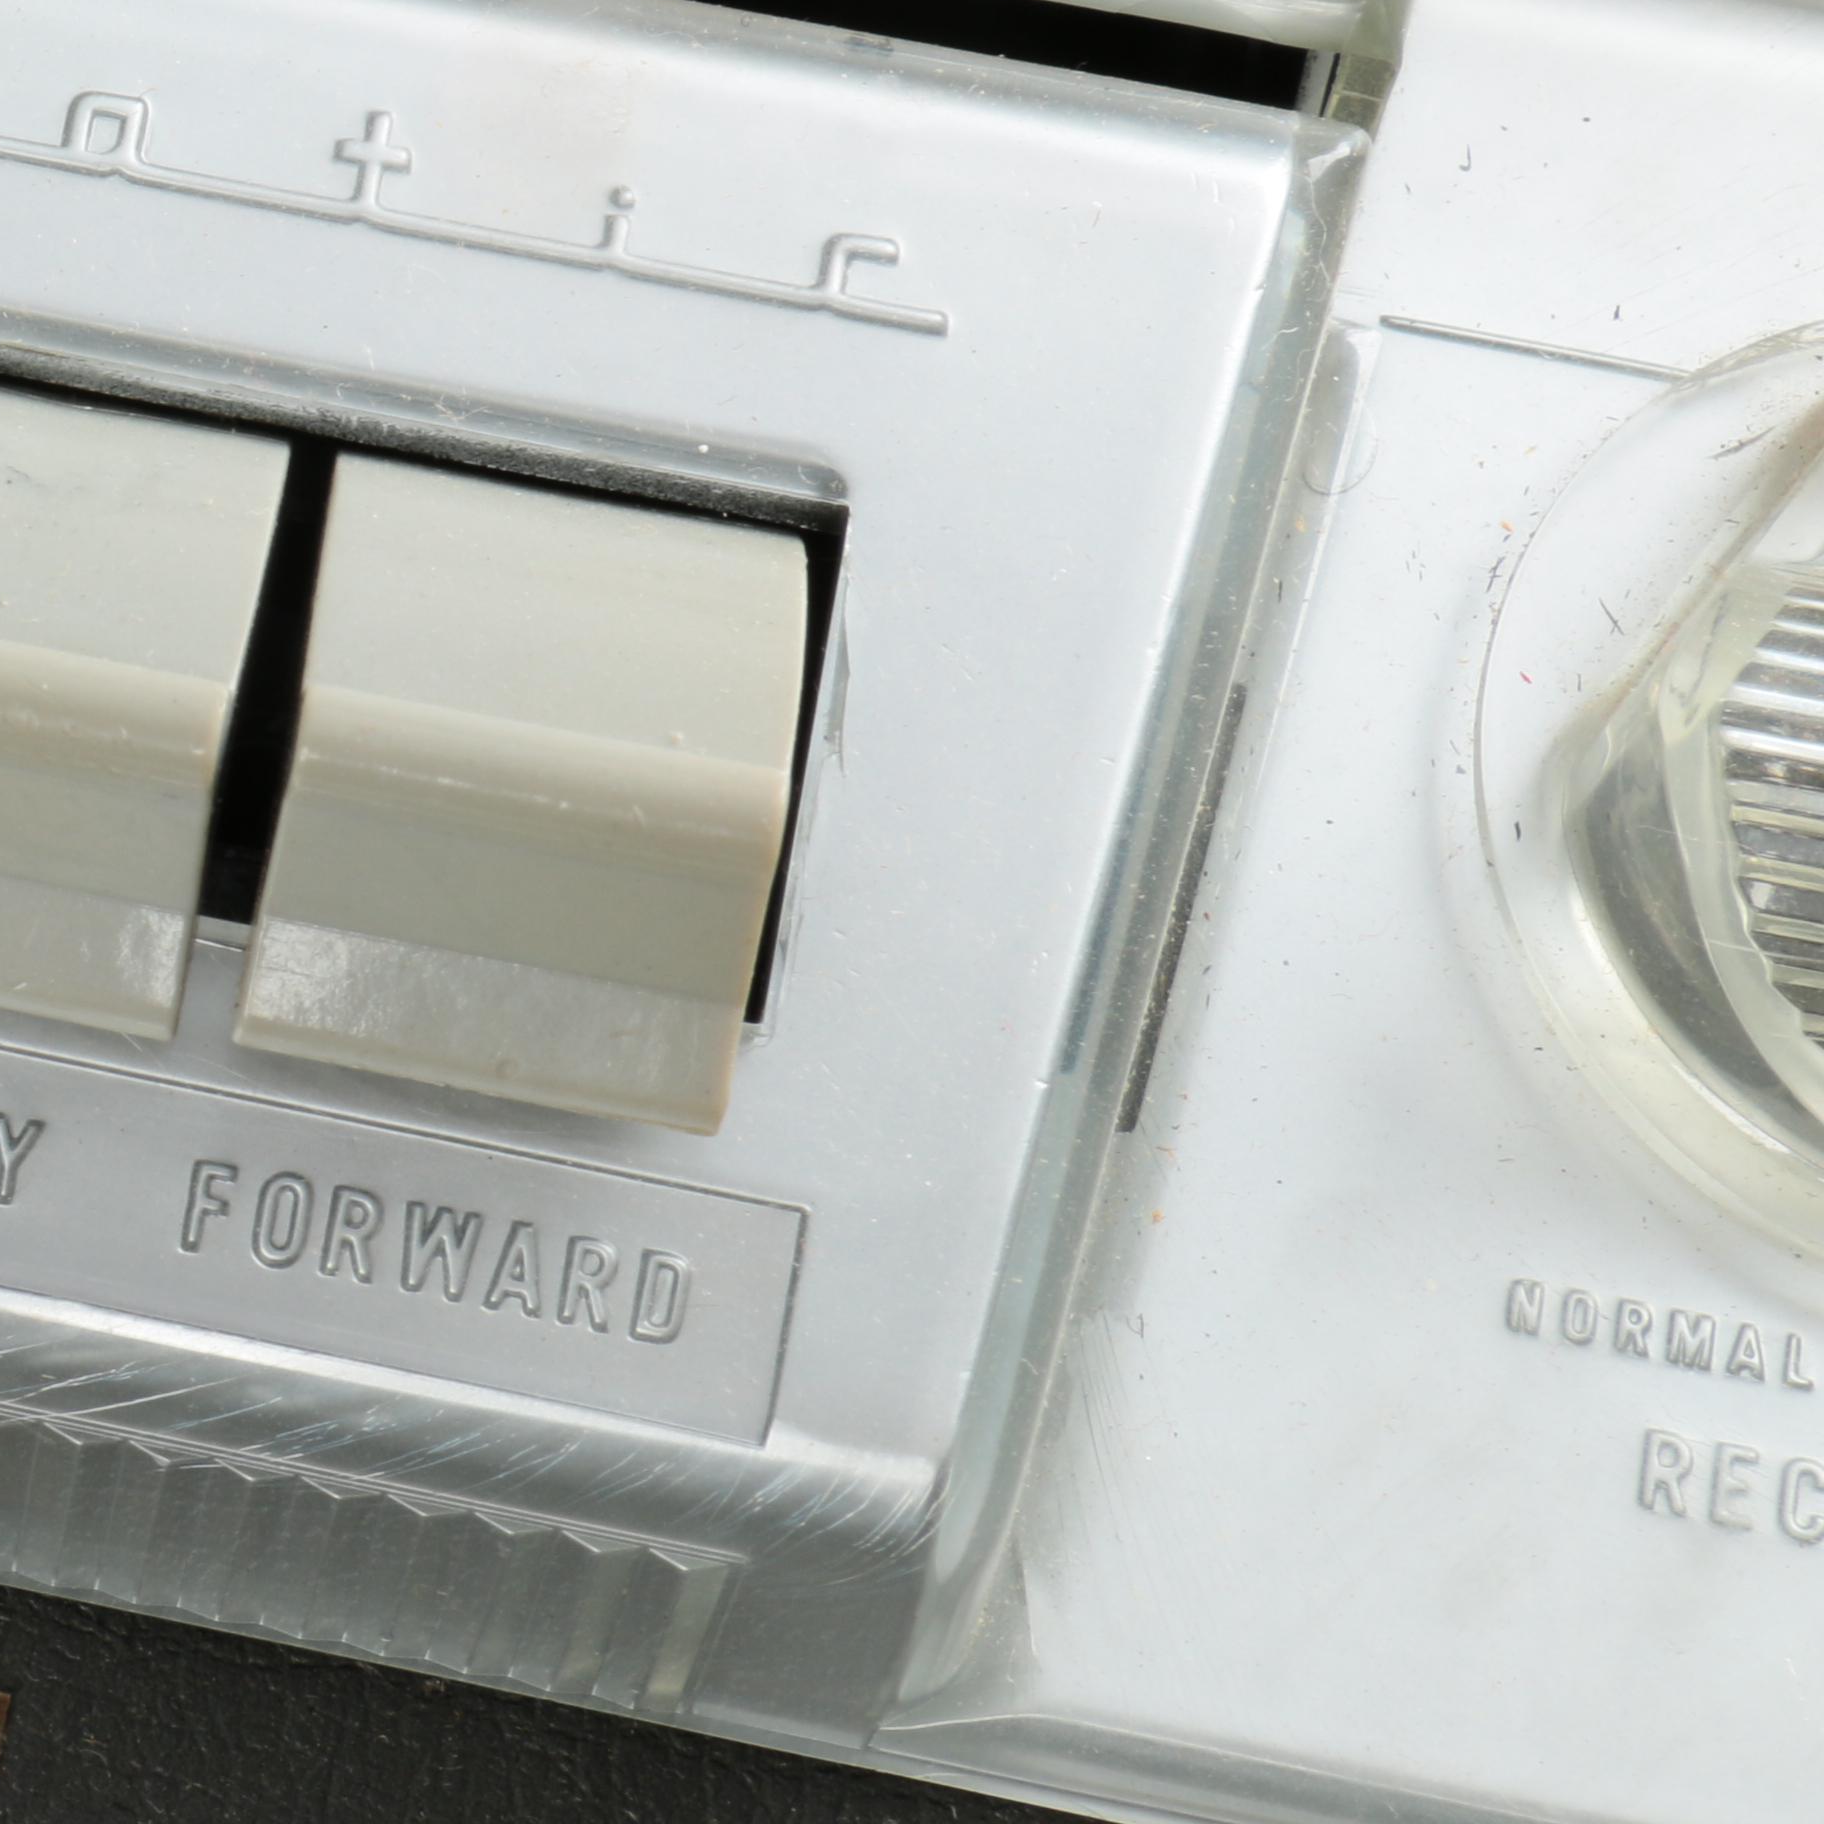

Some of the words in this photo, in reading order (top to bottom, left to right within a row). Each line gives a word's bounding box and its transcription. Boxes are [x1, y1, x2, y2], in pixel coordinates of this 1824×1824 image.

[181, 1160, 696, 1347] FORWARD
[1505, 1278, 1815, 1391] NORMAL
[1638, 1427, 1824, 1548] REC
